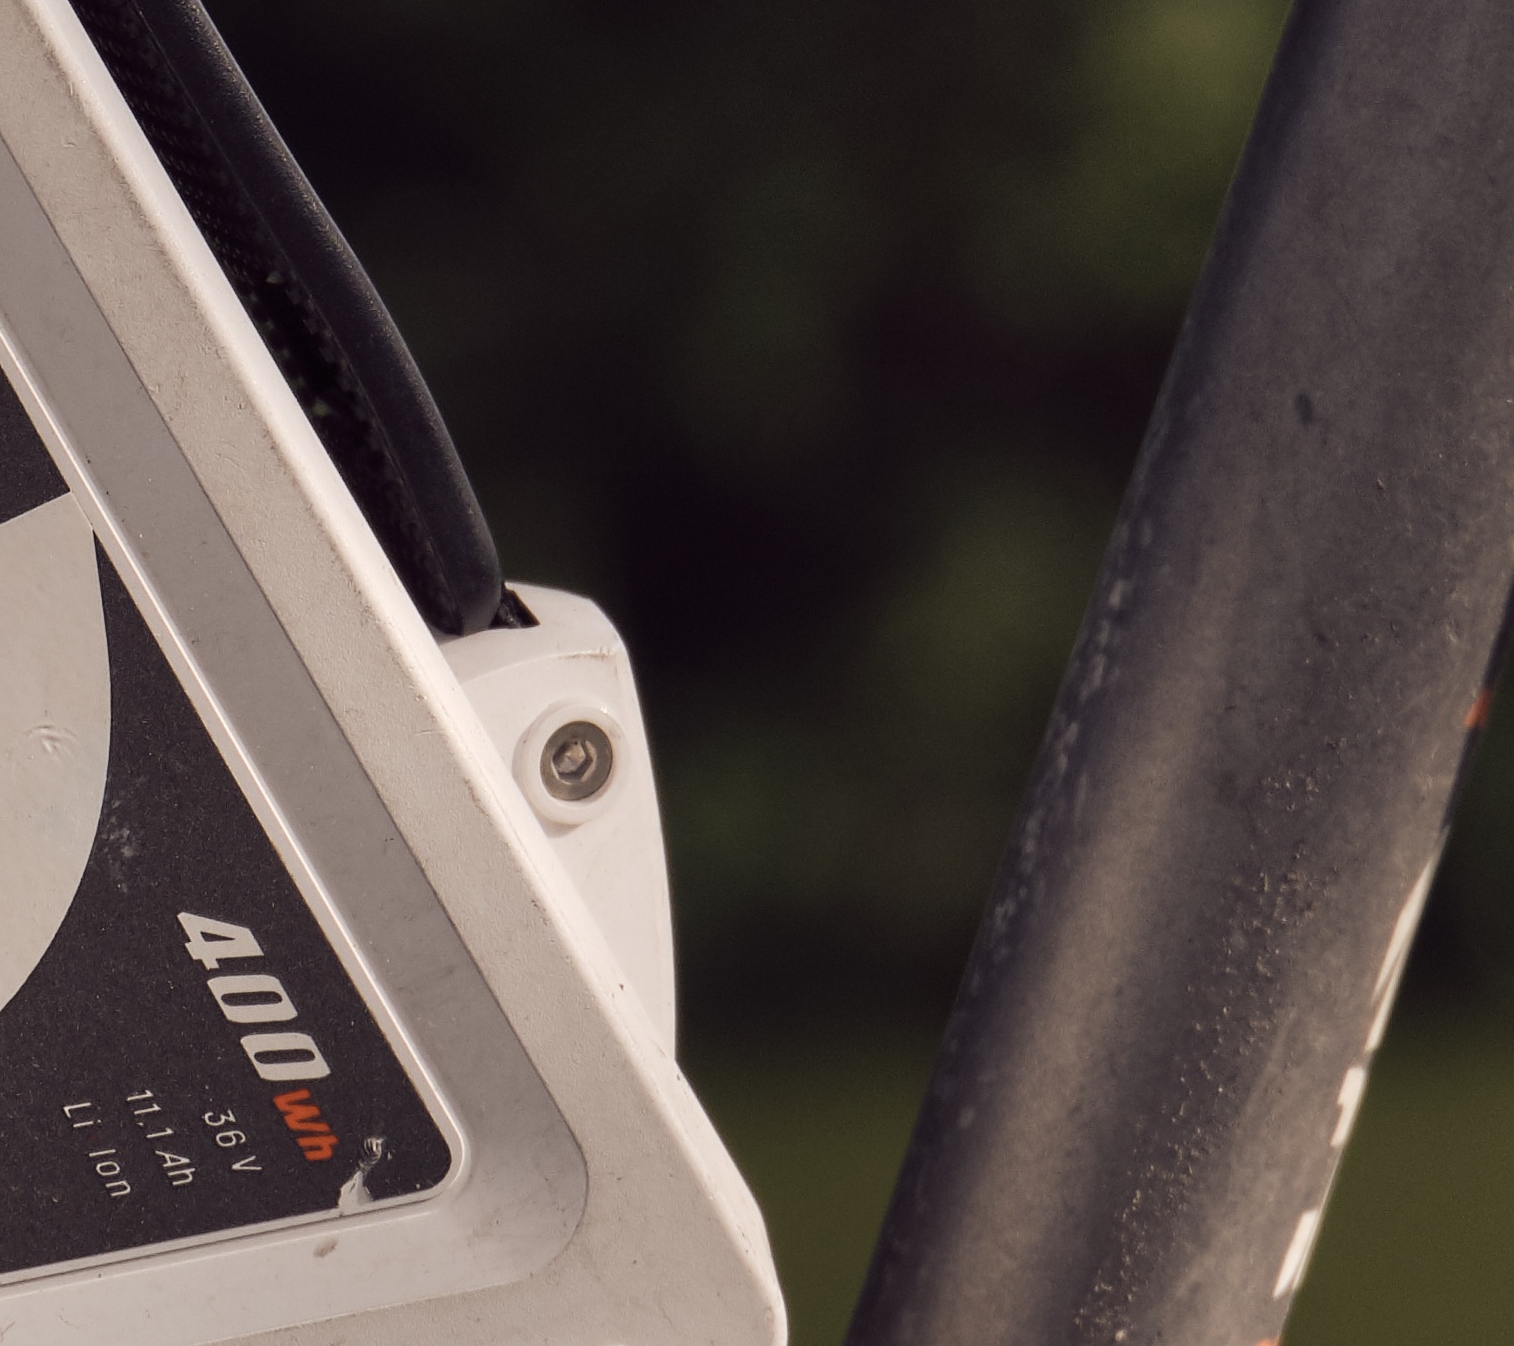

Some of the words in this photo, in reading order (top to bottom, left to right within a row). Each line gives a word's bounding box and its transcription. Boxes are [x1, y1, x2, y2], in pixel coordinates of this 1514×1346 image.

[63, 1101, 101, 1129] Li
[203, 1109, 247, 1149] 36
[231, 1155, 262, 1173] V
[155, 1149, 197, 1187] Ah
